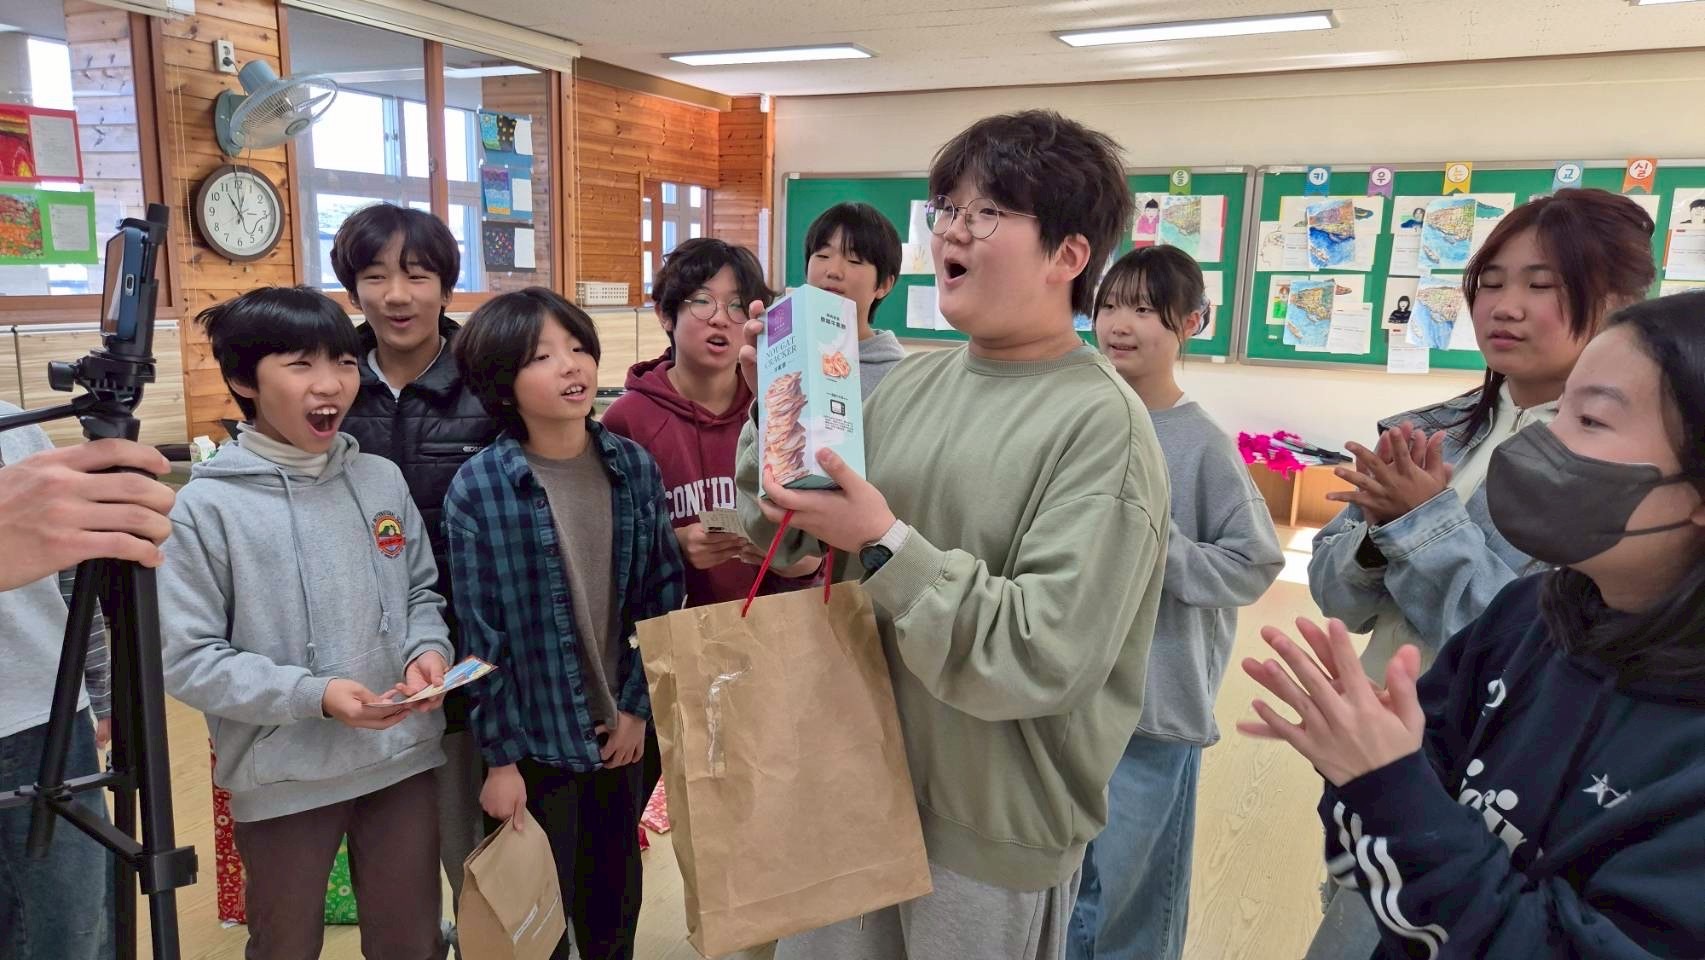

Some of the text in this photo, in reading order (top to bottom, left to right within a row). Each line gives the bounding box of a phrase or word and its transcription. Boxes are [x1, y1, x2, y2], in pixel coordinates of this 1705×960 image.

[1313, 172, 1324, 180] 키
[1376, 171, 1386, 184] 우
[1563, 168, 1574, 179] 교
[1634, 162, 1648, 177] 실
[220, 183, 229, 192] 11
[234, 180, 243, 190] 12
[249, 184, 253, 194] 1
[211, 192, 220, 201] 10
[257, 194, 263, 204] 2
[209, 207, 215, 217] 9
[214, 222, 220, 232] 8
[258, 225, 264, 234] 4
[224, 233, 229, 243] 7
[237, 237, 243, 247] 6
[249, 234, 255, 244] 5
[766, 336, 796, 358] NOUGAT
[765, 345, 798, 369] CRACKER
